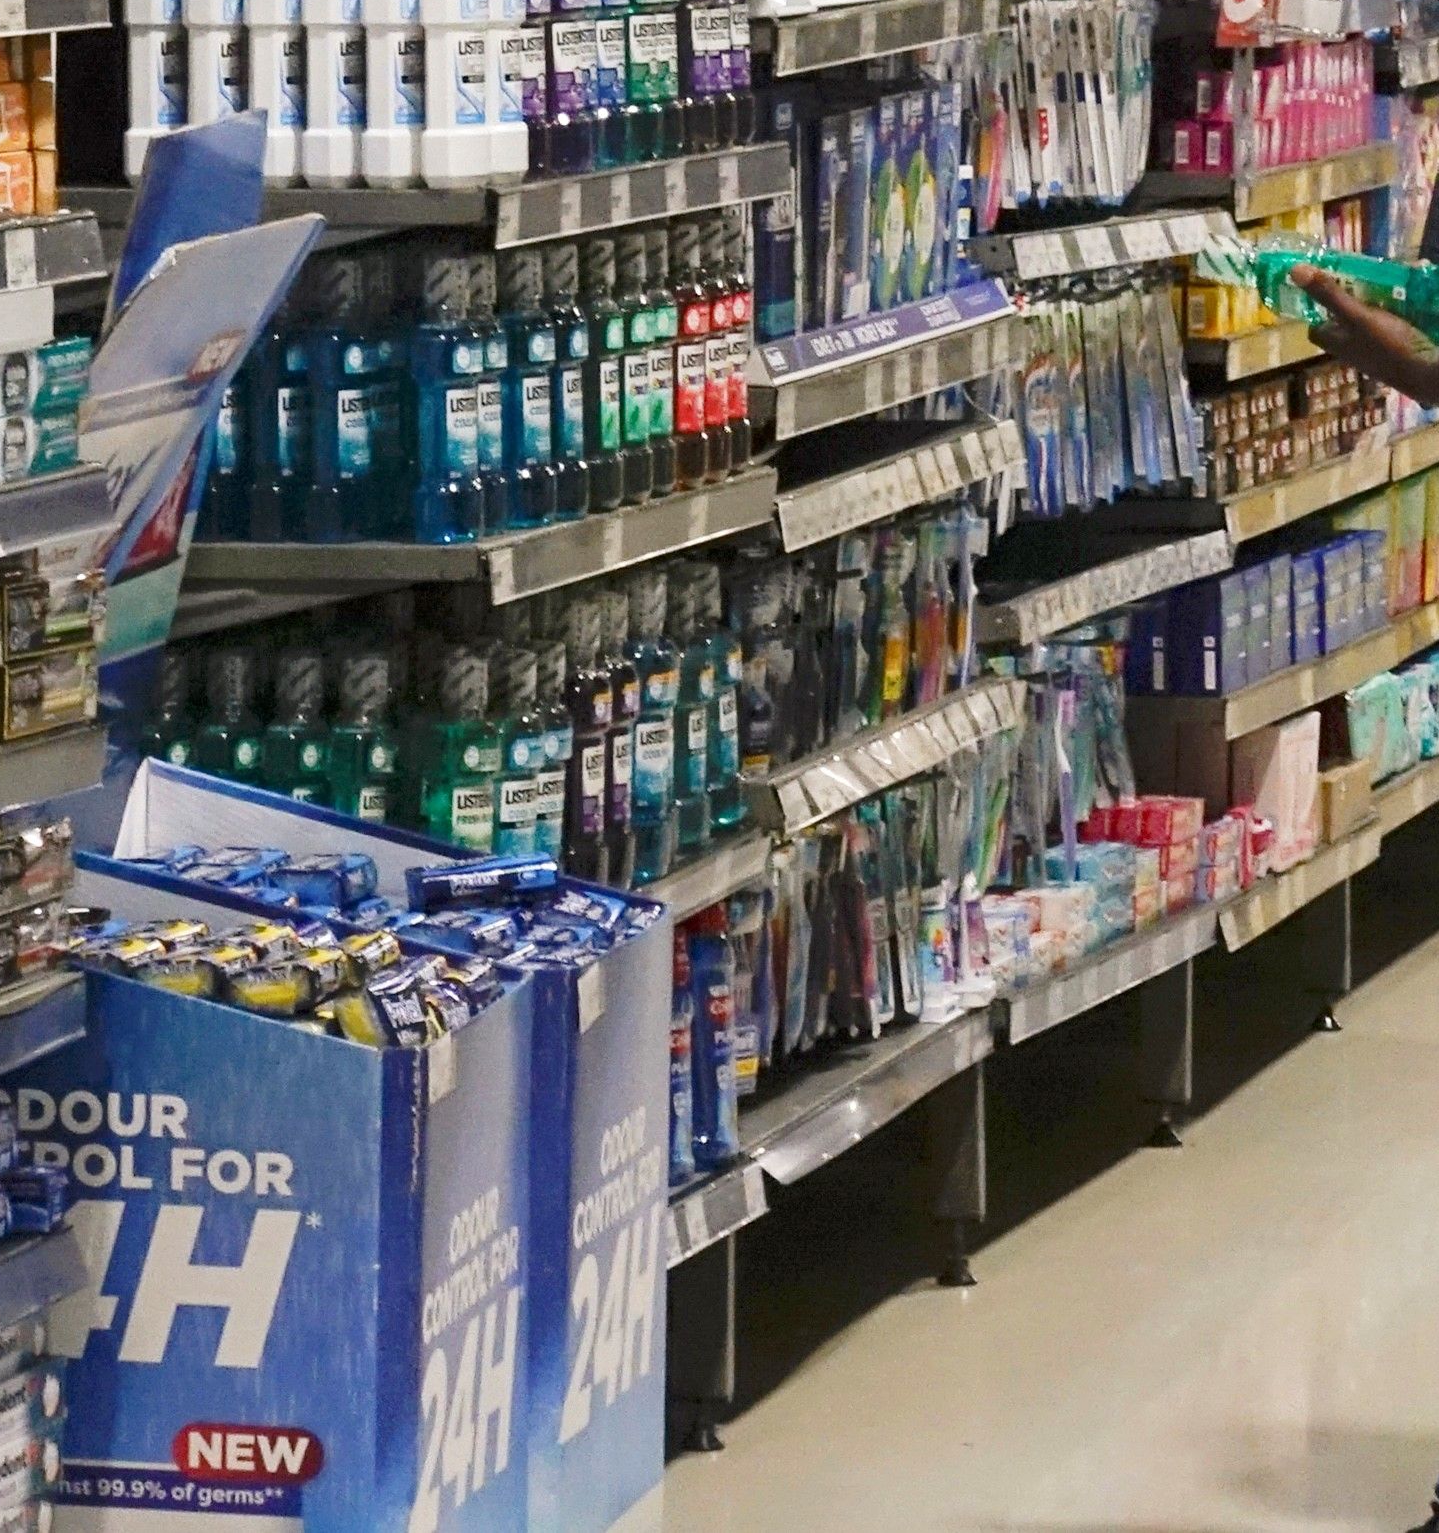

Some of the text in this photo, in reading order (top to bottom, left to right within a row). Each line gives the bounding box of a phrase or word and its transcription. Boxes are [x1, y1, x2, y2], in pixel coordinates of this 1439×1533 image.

[171, 1148, 294, 1196] FOR
[601, 1105, 646, 1177] ODOUR
[449, 1186, 499, 1265] ODOUR
[573, 1165, 633, 1250] CONTROL
[423, 1227, 520, 1345] CONTROL FOR
[558, 1200, 661, 1444] 24H
[407, 1286, 520, 1533] 24H
[98, 1478, 166, 1500] 99.9%
[171, 1481, 190, 1502] of
[188, 1430, 309, 1475] NEW
